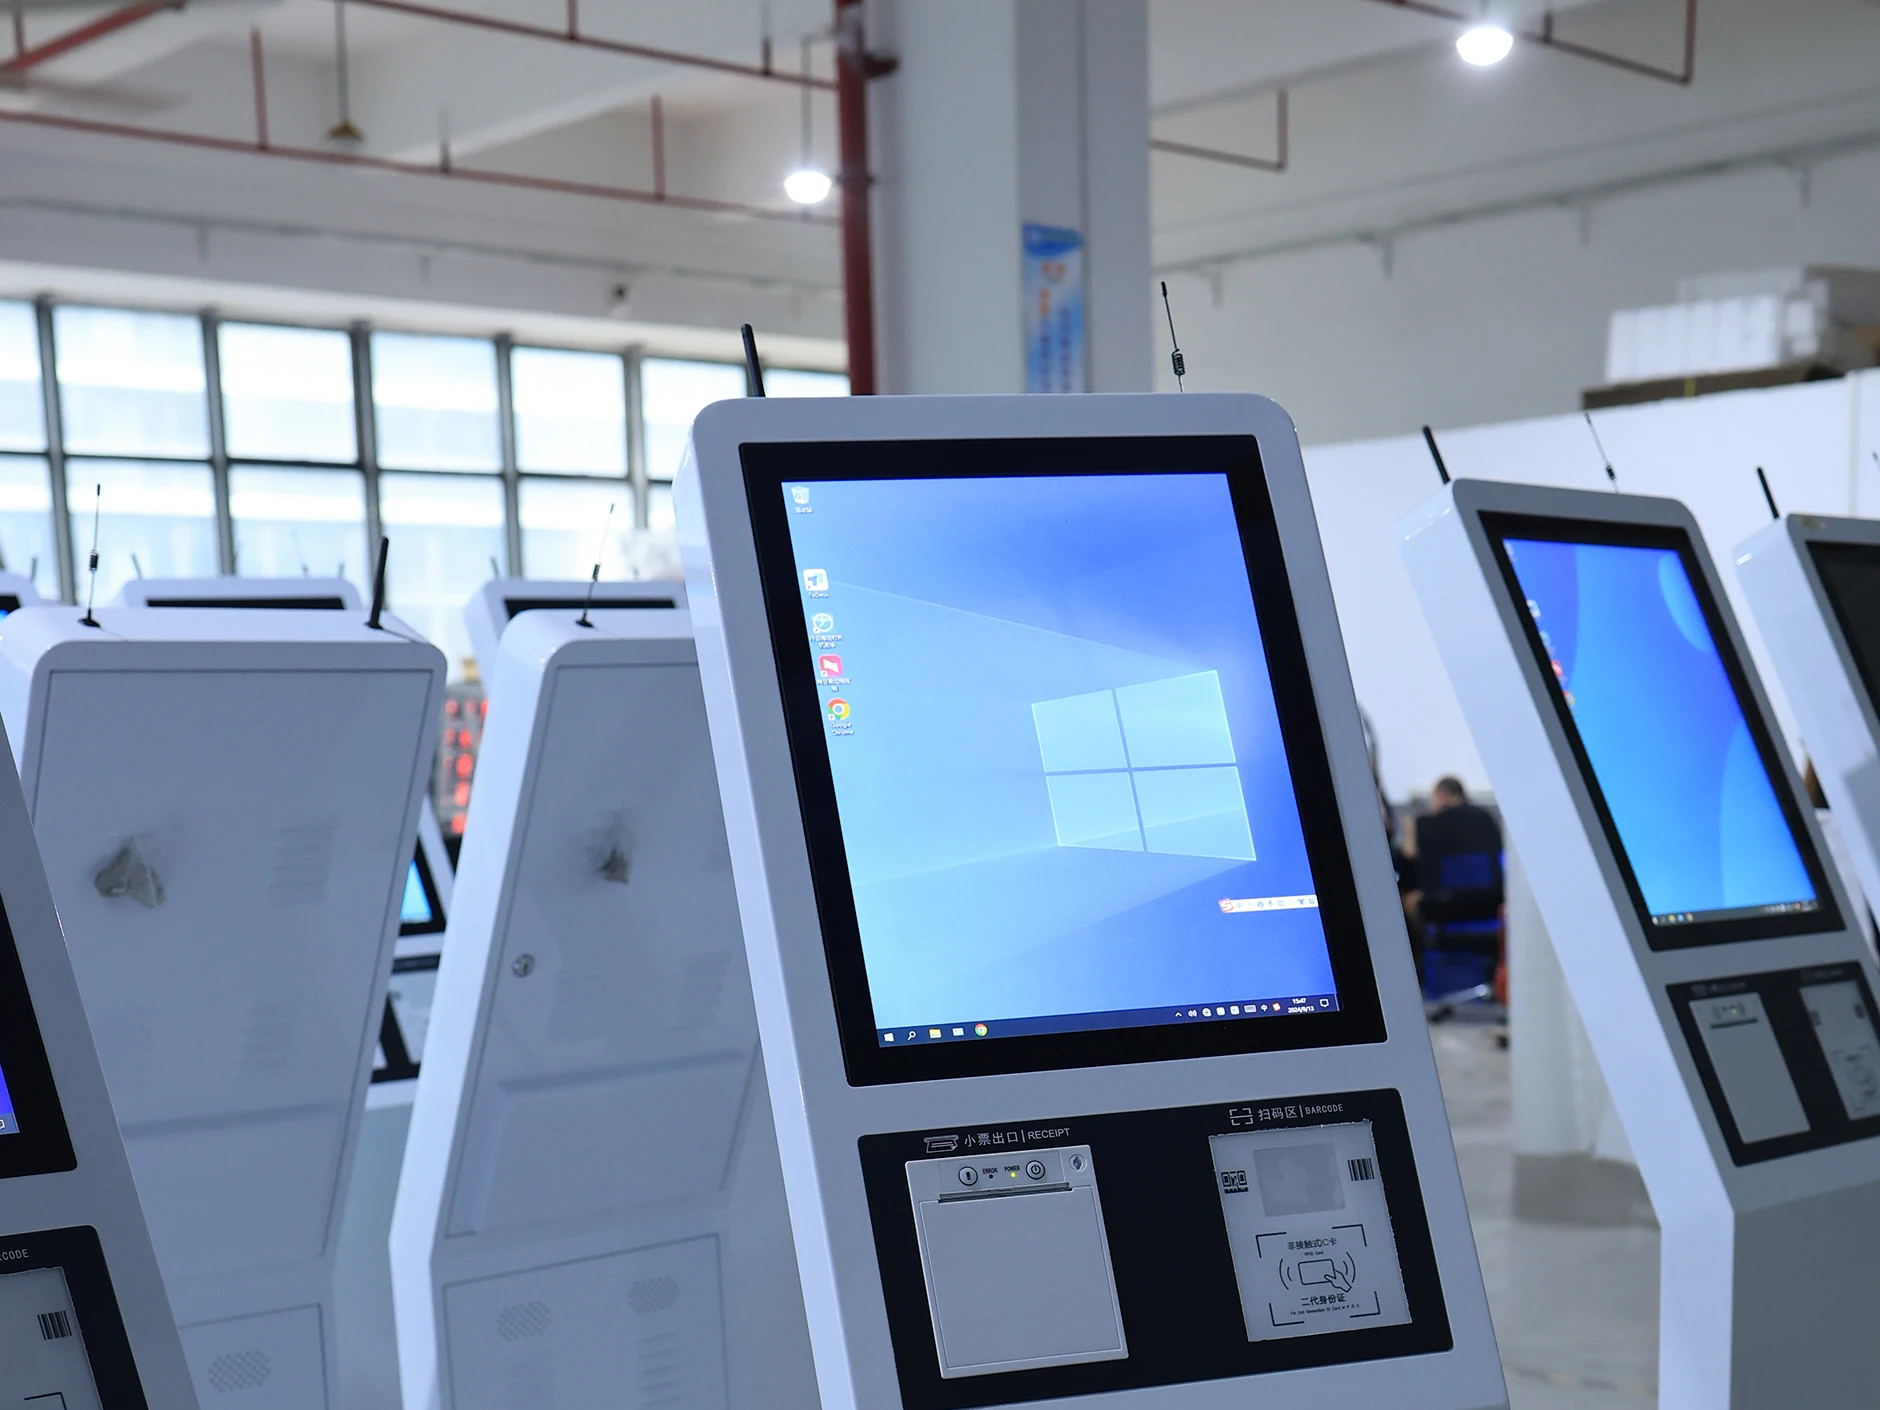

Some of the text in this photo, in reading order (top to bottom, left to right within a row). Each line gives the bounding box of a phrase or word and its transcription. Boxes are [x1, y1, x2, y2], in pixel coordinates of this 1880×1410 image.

[1258, 1103, 1344, 1121] 扫码区 BARCODE
[964, 1127, 1070, 1148] 小票出口 RECEIPT
[0, 1248, 29, 1261] CODE
[1301, 1293, 1346, 1306] 二代身份证
